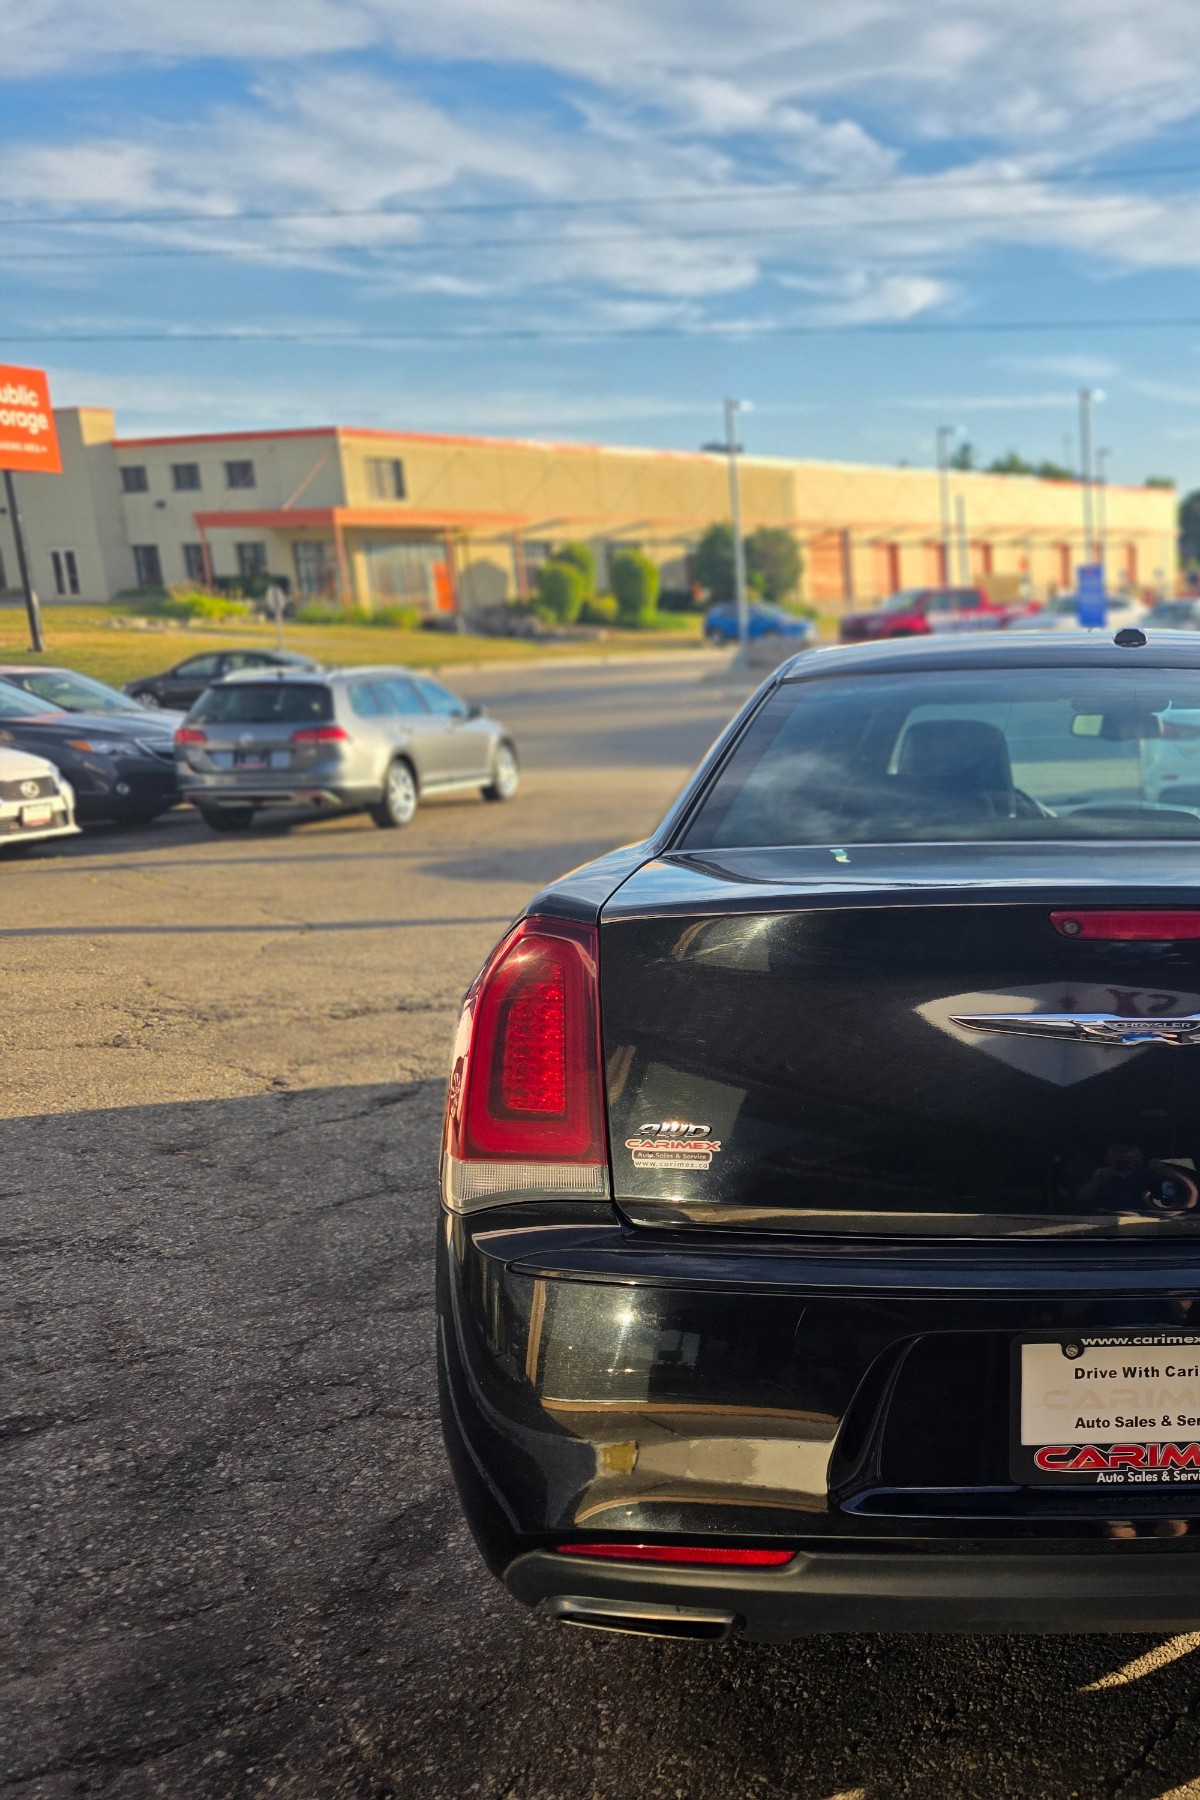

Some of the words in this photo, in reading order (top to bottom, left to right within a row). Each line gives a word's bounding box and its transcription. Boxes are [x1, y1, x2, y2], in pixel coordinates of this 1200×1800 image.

[633, 1121, 711, 1138] AWD
[626, 1139, 721, 1150] CARIMEX
[635, 1160, 708, 1169] www.carimex.ca
[1074, 1367, 1117, 1379] Drive
[1122, 1366, 1159, 1378] With
[1075, 1416, 1110, 1429] Auto
[1115, 1415, 1156, 1428] Sales
[1161, 1415, 1172, 1427] &
[1097, 1471, 1124, 1483] Auto
[1128, 1471, 1159, 1482] Sales
[1161, 1471, 1171, 1482] &
